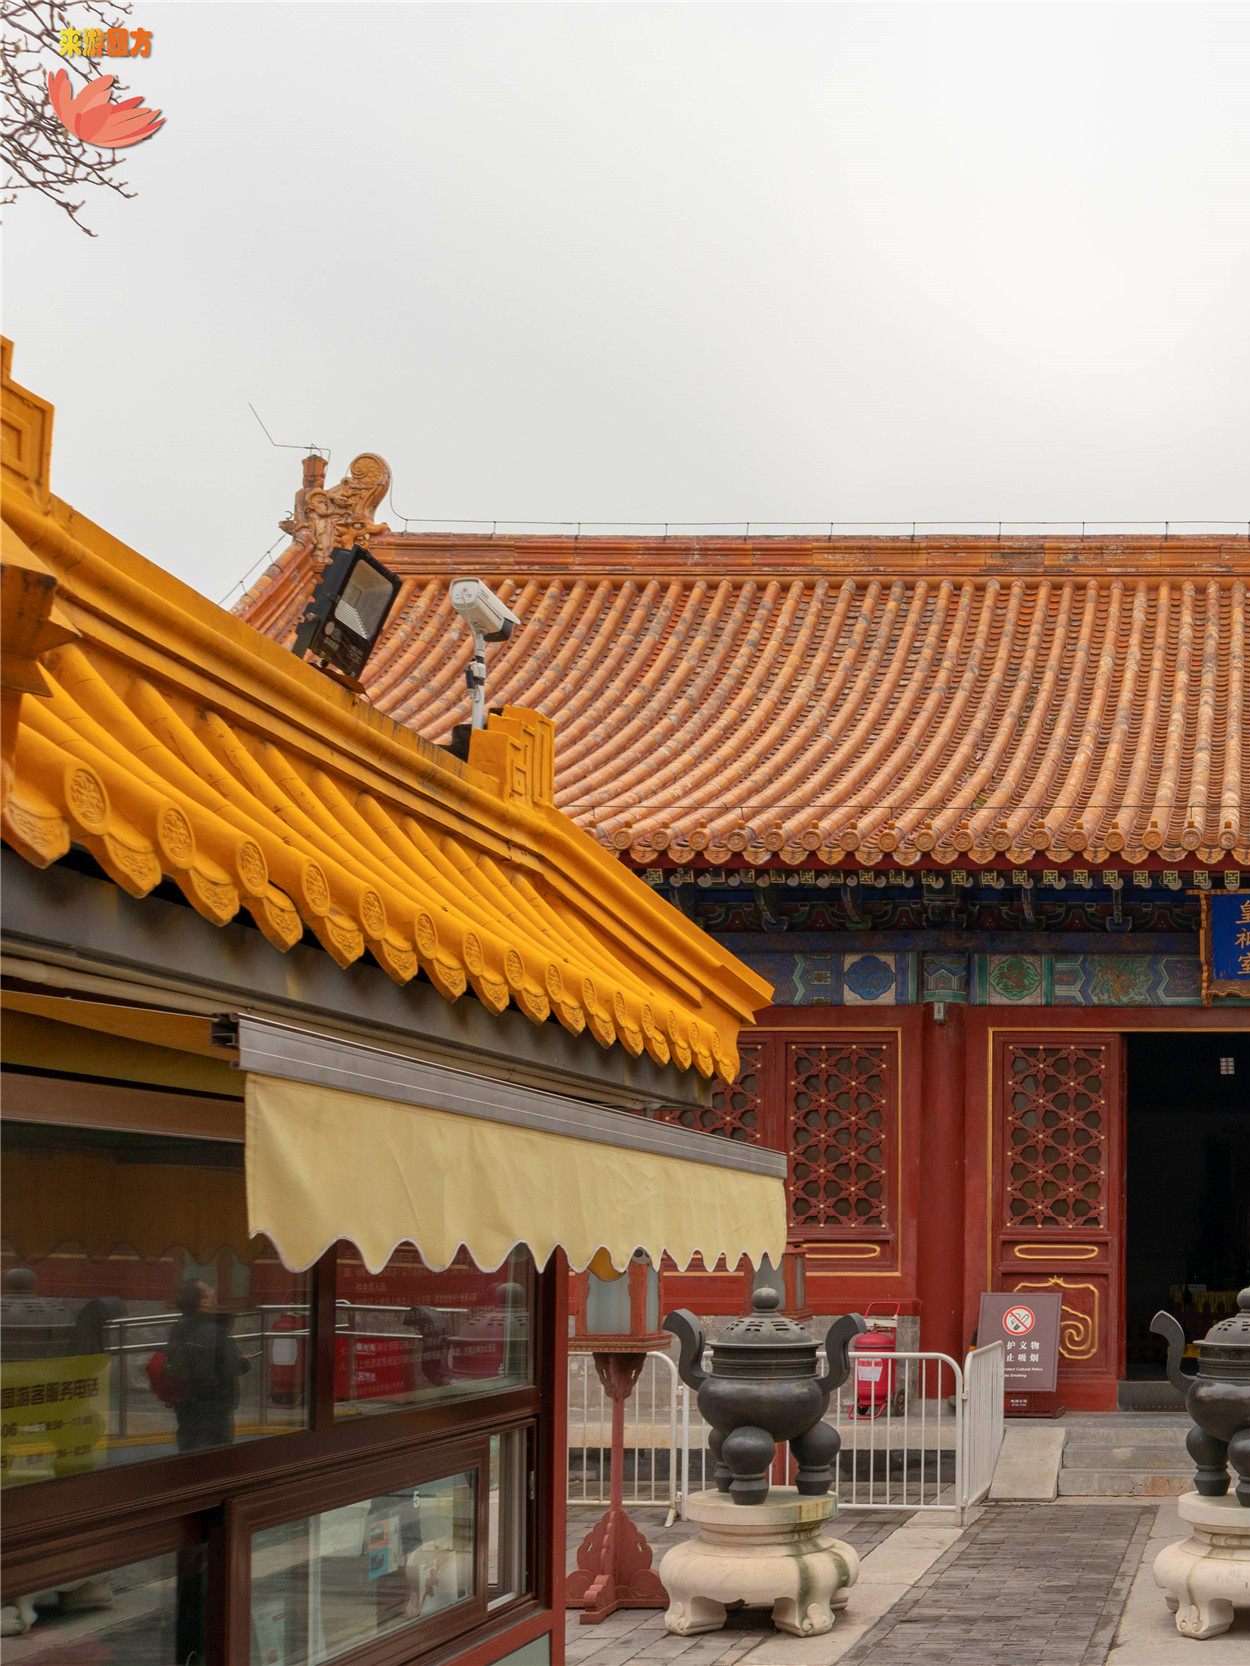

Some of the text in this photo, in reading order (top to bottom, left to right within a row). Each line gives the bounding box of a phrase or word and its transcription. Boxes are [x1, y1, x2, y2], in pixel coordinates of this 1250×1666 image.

[1006, 1341, 1040, 1350] 护文物
[1006, 1353, 1040, 1362] 止吸烟
[413, 1491, 420, 1508] 5
